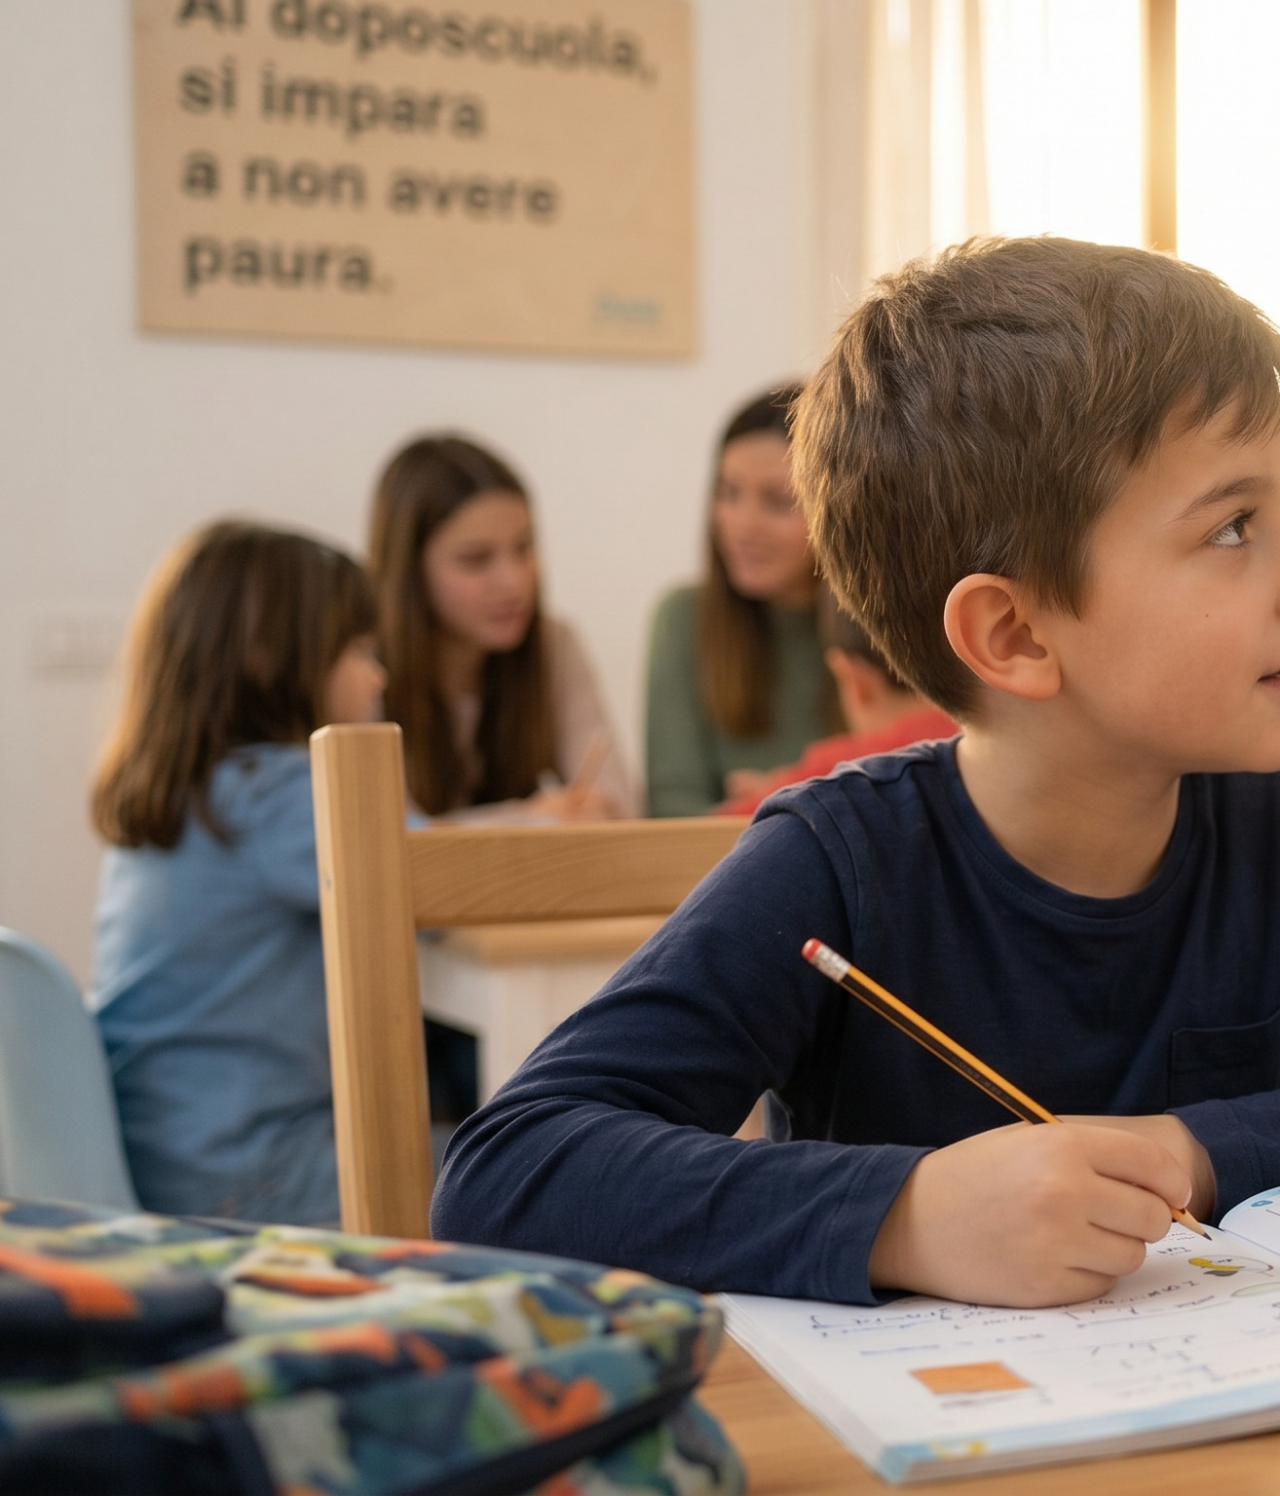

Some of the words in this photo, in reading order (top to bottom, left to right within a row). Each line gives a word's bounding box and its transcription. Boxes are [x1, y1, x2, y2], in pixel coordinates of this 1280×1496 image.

[179, 57, 237, 114] si
[260, 62, 485, 141] impara
[181, 151, 221, 198] a
[241, 156, 368, 208] non
[386, 168, 559, 224] avere
[180, 233, 389, 299] paura.
